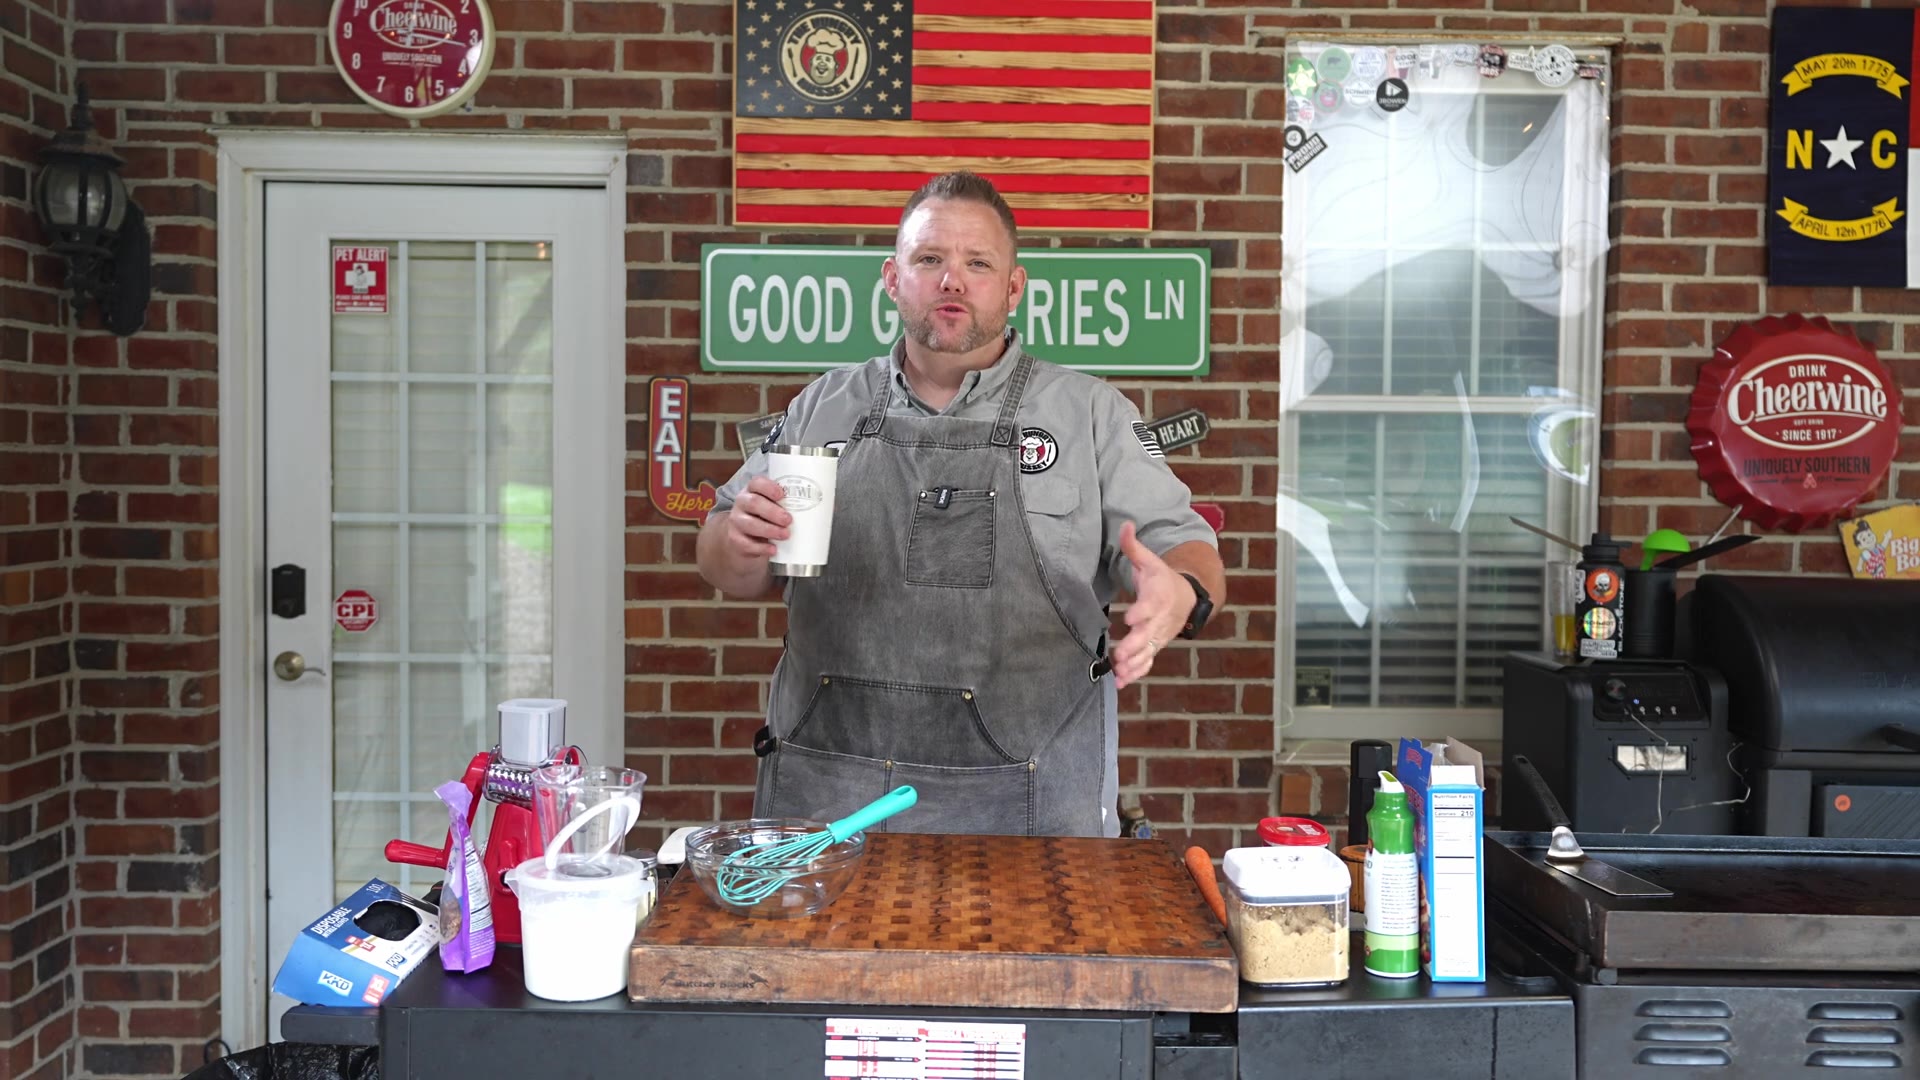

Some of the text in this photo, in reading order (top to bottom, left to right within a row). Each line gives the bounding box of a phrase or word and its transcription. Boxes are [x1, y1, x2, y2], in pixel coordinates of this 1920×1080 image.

[460, 0, 470, 14] 2
[343, 22, 352, 39] 9
[369, 6, 458, 35] Cheerwine
[469, 29, 478, 46] 3
[352, 53, 361, 69] 8
[458, 59, 468, 75] 4
[1801, 57, 1891, 78] MAY 20th 1775
[377, 76, 386, 93] 7
[405, 86, 414, 103] 6
[435, 80, 444, 96] 5
[1288, 135, 1321, 164] PROUD
[1786, 129, 1898, 170] N C
[1796, 217, 1887, 237] APRIL 12th 1776
[335, 249, 386, 261] PET ALERT
[728, 273, 1186, 348] GOOD GRIES LN
[1788, 364, 1827, 379] DRINK
[1727, 373, 1888, 426] Cheerwine
[655, 386, 682, 488] EAT
[1158, 415, 1200, 445] HEART
[1782, 428, 1837, 442] SINCE 1917
[1743, 456, 1872, 478] UNIQUELY SOUTHERN
[665, 492, 713, 513] Here
[1891, 536, 1920, 557] Big
[1896, 553, 1920, 573] Bo
[337, 603, 374, 617] CPI
[1460, 810, 1474, 818] 210
[310, 906, 352, 934] DISPOSABLE
